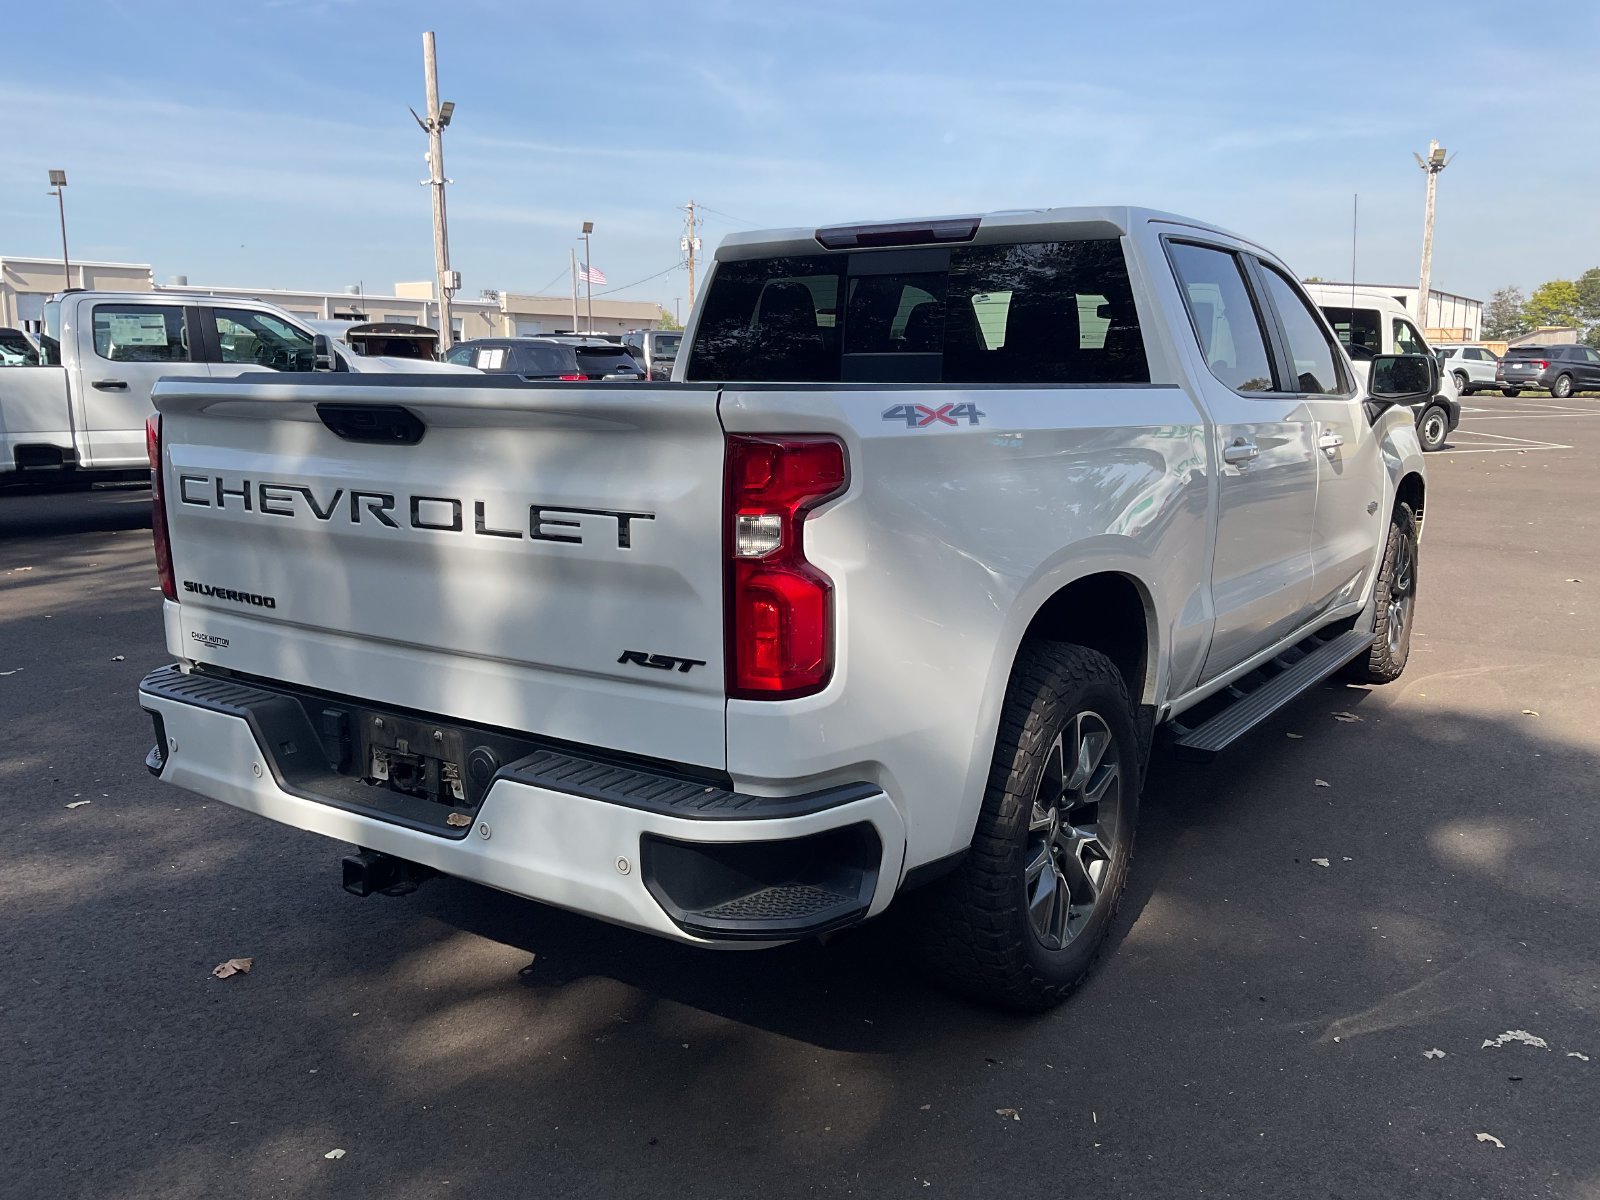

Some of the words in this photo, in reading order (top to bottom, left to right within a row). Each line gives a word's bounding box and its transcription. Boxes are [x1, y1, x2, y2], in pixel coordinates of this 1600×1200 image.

[881, 402, 986, 429] 4X4
[180, 474, 656, 550] CHEVROLET
[183, 580, 276, 609] SILVERADO
[191, 631, 208, 641] CHUCK
[208, 635, 230, 646] HUTTON
[617, 649, 707, 674] RST
